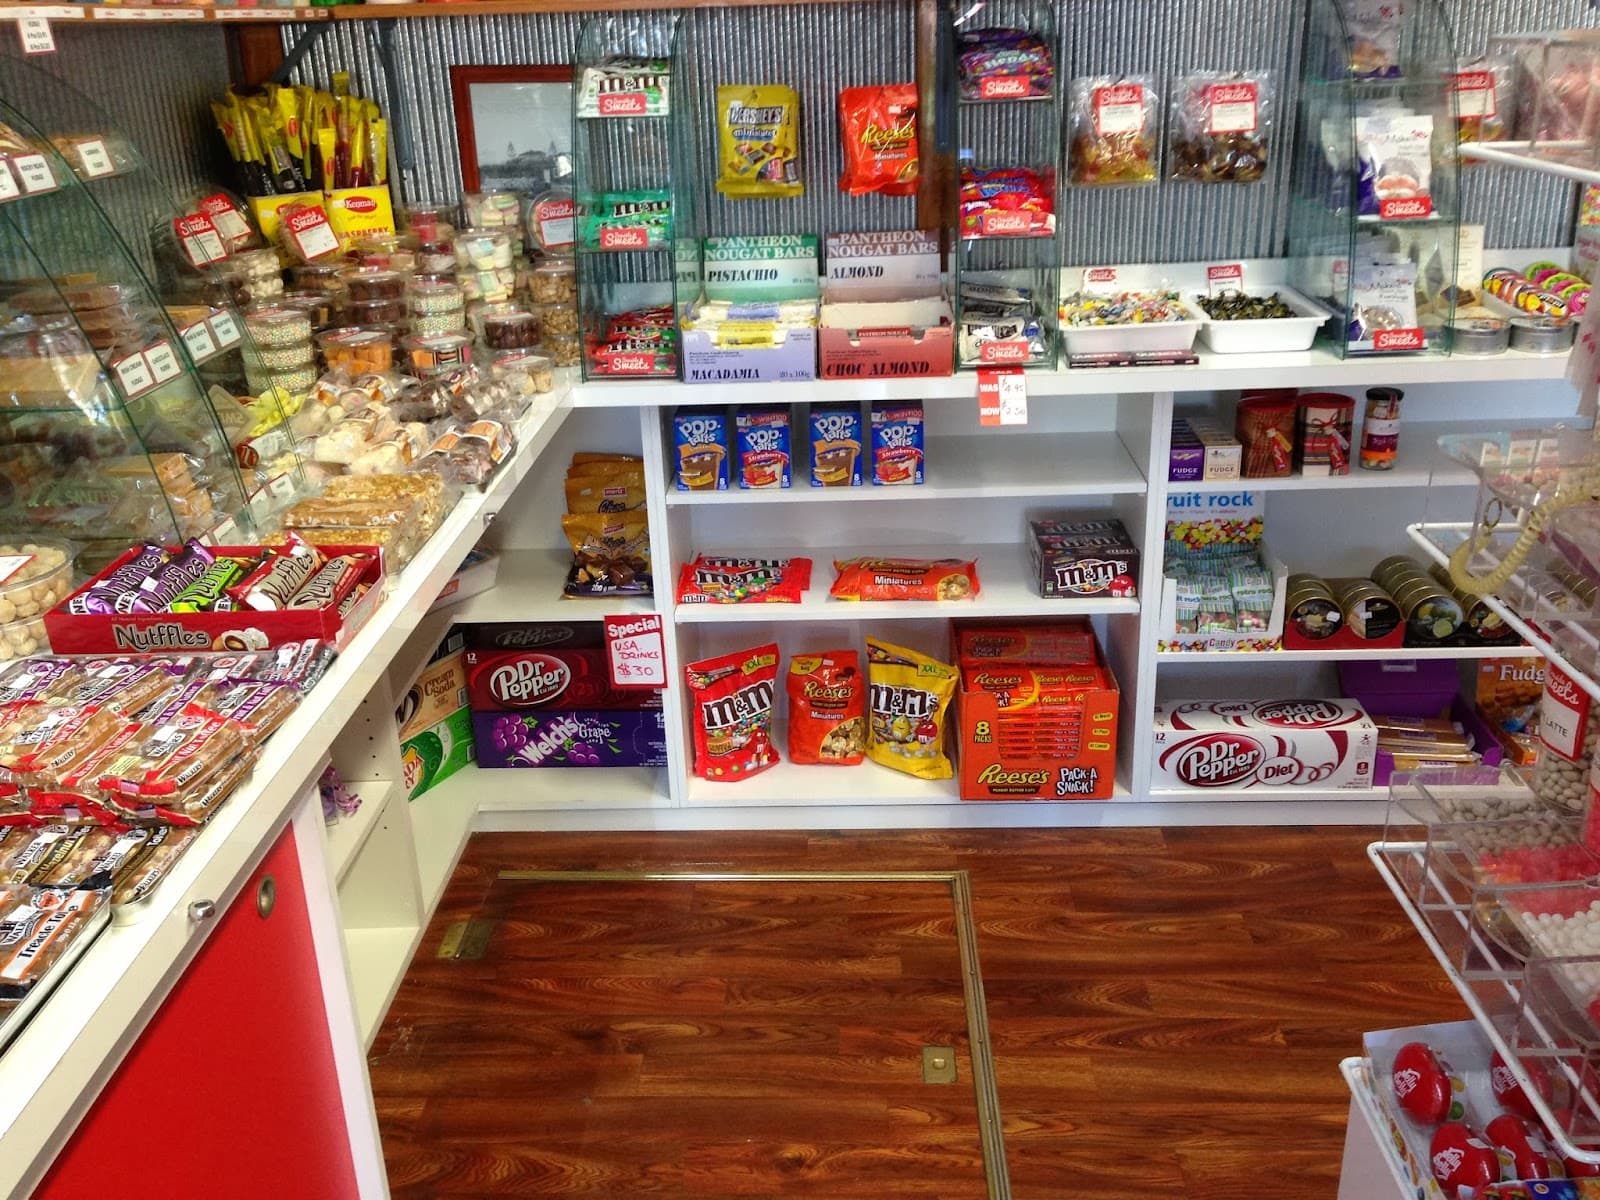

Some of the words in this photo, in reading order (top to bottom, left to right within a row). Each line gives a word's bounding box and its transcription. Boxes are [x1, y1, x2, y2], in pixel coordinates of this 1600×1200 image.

[603, 98, 642, 113] Sweets
[1384, 203, 1427, 216] Sweets
[605, 232, 643, 247] Sweets
[717, 235, 802, 249] PANTHEON
[840, 231, 926, 245] PANTHEON
[705, 247, 772, 260] NOUGAT
[774, 246, 815, 258] BARS
[828, 243, 894, 258] NOUGAT
[896, 241, 938, 254] BARS
[708, 269, 778, 283] PISTACHIO
[830, 265, 884, 280] ALMOND
[1378, 333, 1419, 347] Sweets
[986, 346, 1024, 360] Sweets
[612, 356, 650, 371] Sweets
[826, 363, 865, 376] CHOC
[868, 361, 930, 376] ALMOND
[691, 368, 760, 380] MACADAMIA
[980, 384, 999, 392] WAS
[980, 407, 1000, 416] NOW
[1167, 492, 1201, 507] ruit
[1208, 491, 1253, 507] rock
[874, 575, 922, 586] Miniatures
[608, 617, 660, 638] Special
[113, 624, 210, 650] Nutffles
[619, 652, 659, 660] DRINKS
[516, 661, 545, 681] Dr
[1500, 664, 1545, 685] Fudg
[500, 667, 566, 700] Pepper
[803, 682, 853, 700] Reese's
[1042, 695, 1071, 703] Reese's
[811, 710, 844, 721] Miniatures
[578, 724, 612, 744] Grape
[976, 721, 990, 735] 8
[519, 715, 579, 764] Welch's
[974, 735, 992, 743] PACKS
[1155, 733, 1165, 741] 12
[1211, 741, 1239, 761] Dr
[1188, 749, 1260, 781] Pepper
[1263, 763, 1294, 779] Diet
[977, 763, 1050, 785] Reese's
[1061, 767, 1097, 782] PACK-A
[1056, 780, 1094, 796] SNACK!
[17, 927, 52, 959] Treacle
